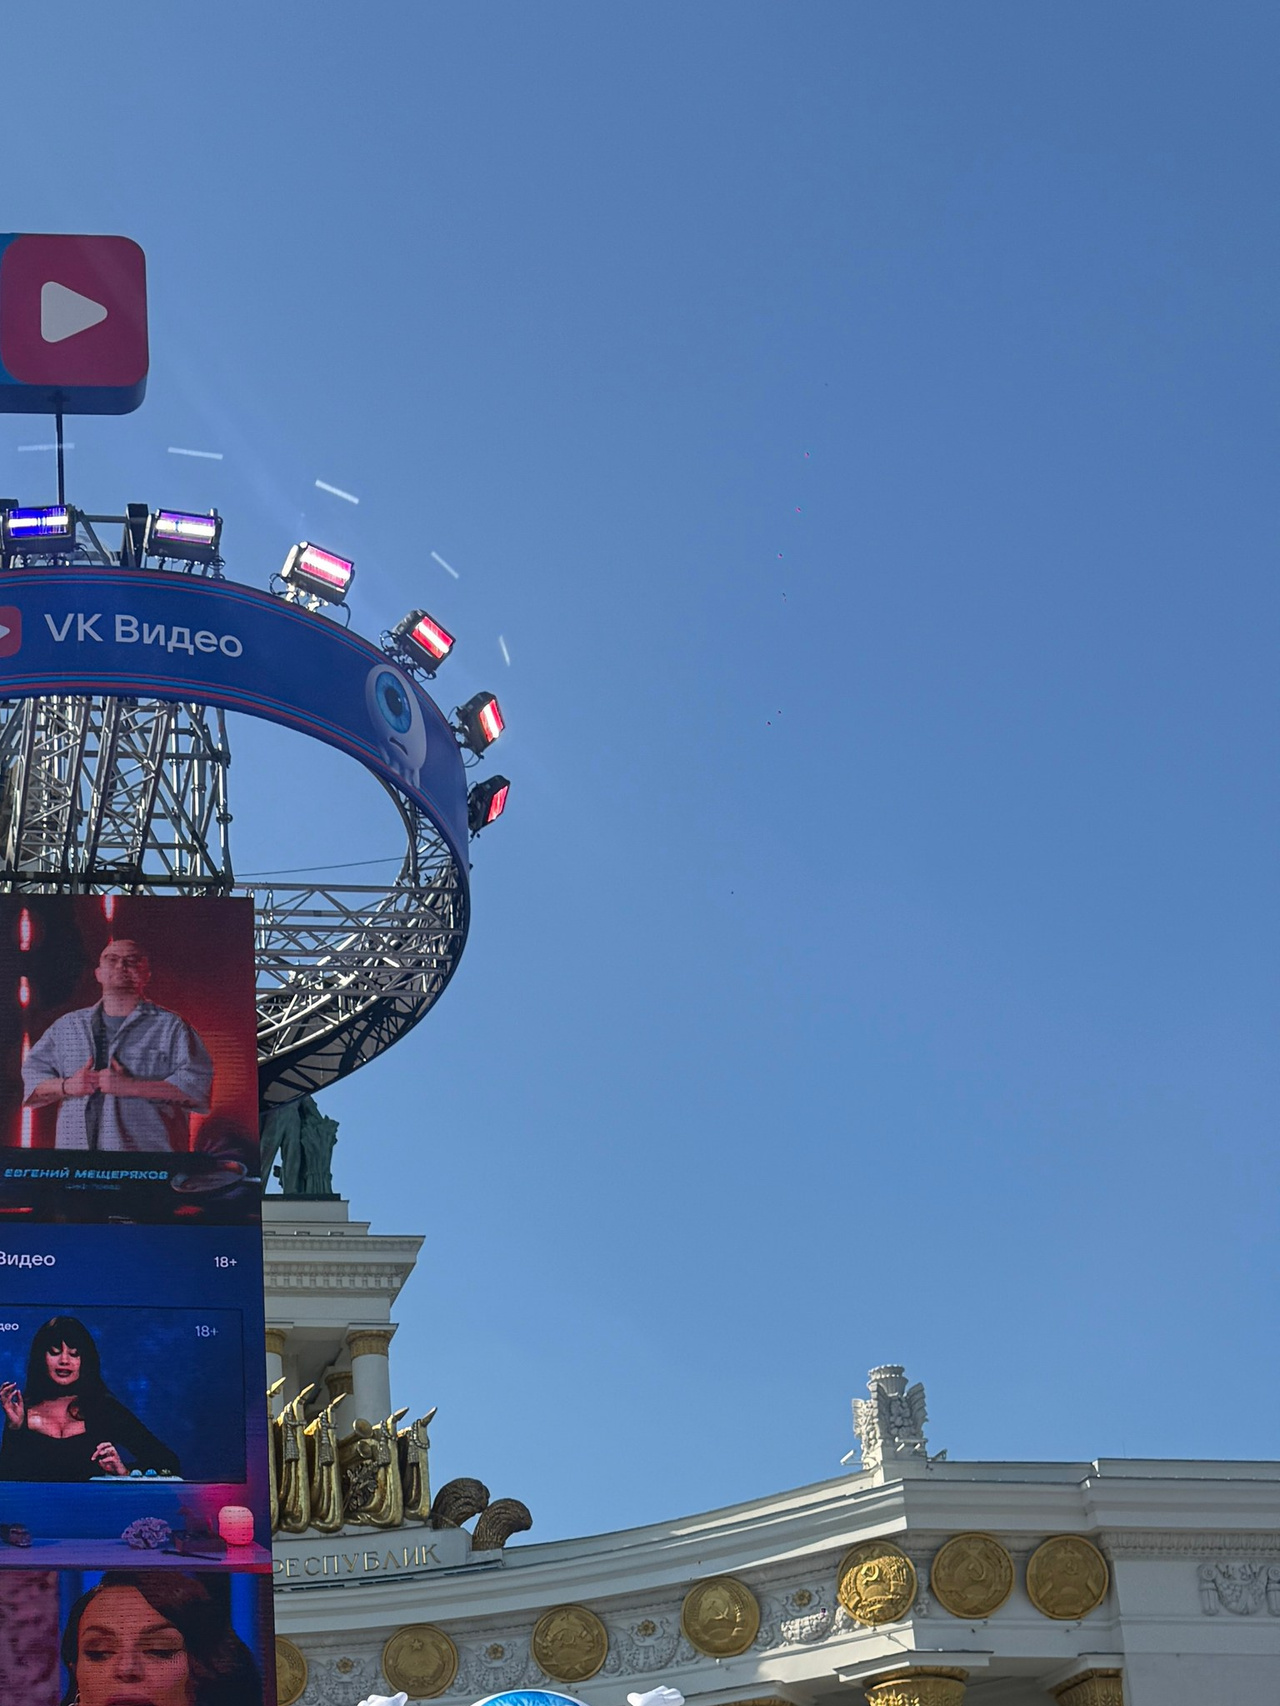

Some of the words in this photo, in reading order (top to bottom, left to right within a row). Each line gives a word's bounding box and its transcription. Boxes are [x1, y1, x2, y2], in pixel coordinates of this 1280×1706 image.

[44, 613, 104, 642] VK
[114, 613, 244, 658] Видео
[3, 1166, 70, 1179] ЕВГЕНИЙ
[214, 1256, 238, 1268] 18+
[195, 1325, 220, 1338] 18+
